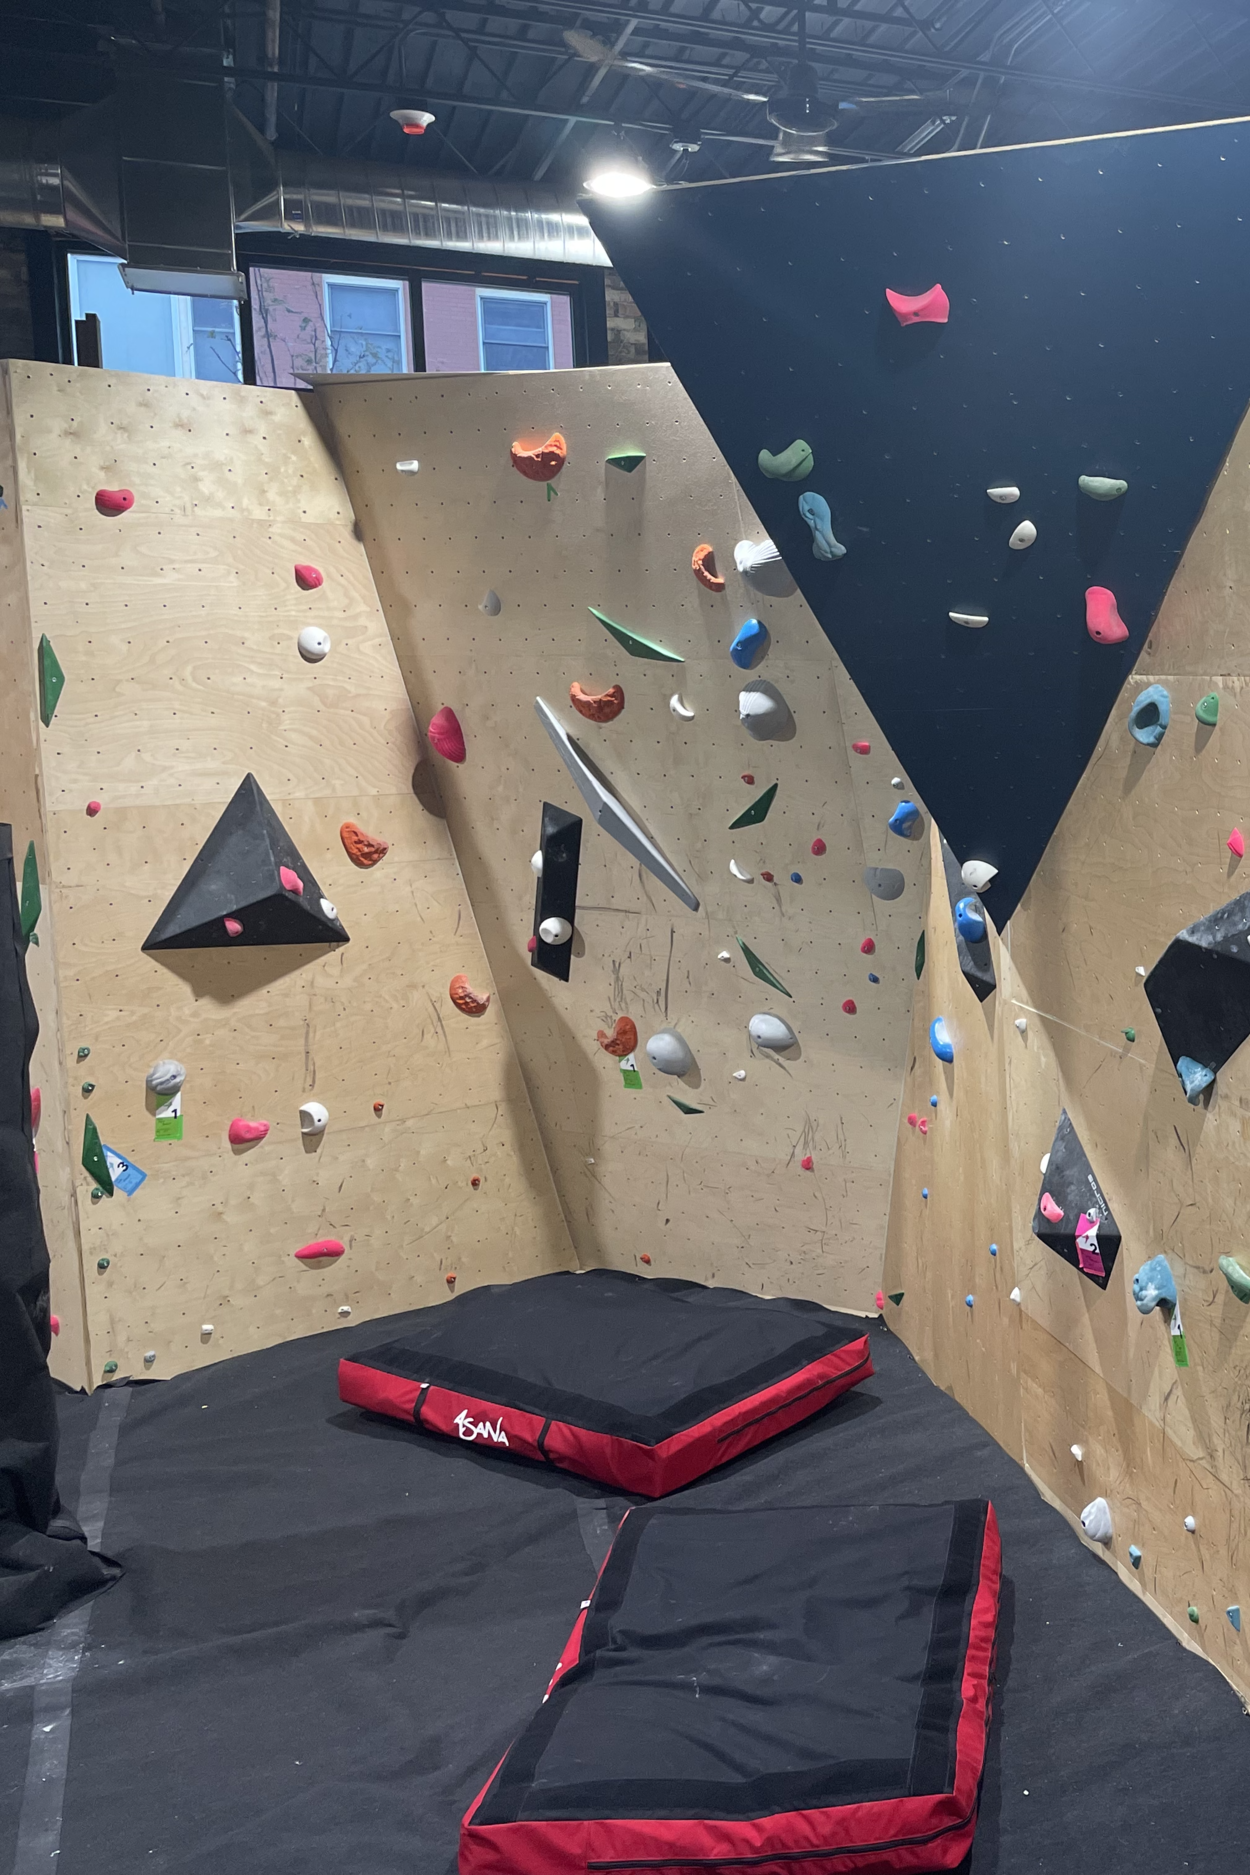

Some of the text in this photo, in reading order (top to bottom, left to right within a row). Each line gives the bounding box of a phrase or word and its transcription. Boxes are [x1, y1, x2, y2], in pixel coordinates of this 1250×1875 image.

[171, 1108, 178, 1120] 1
[117, 1161, 129, 1173] 3
[1089, 1242, 1099, 1255] 2
